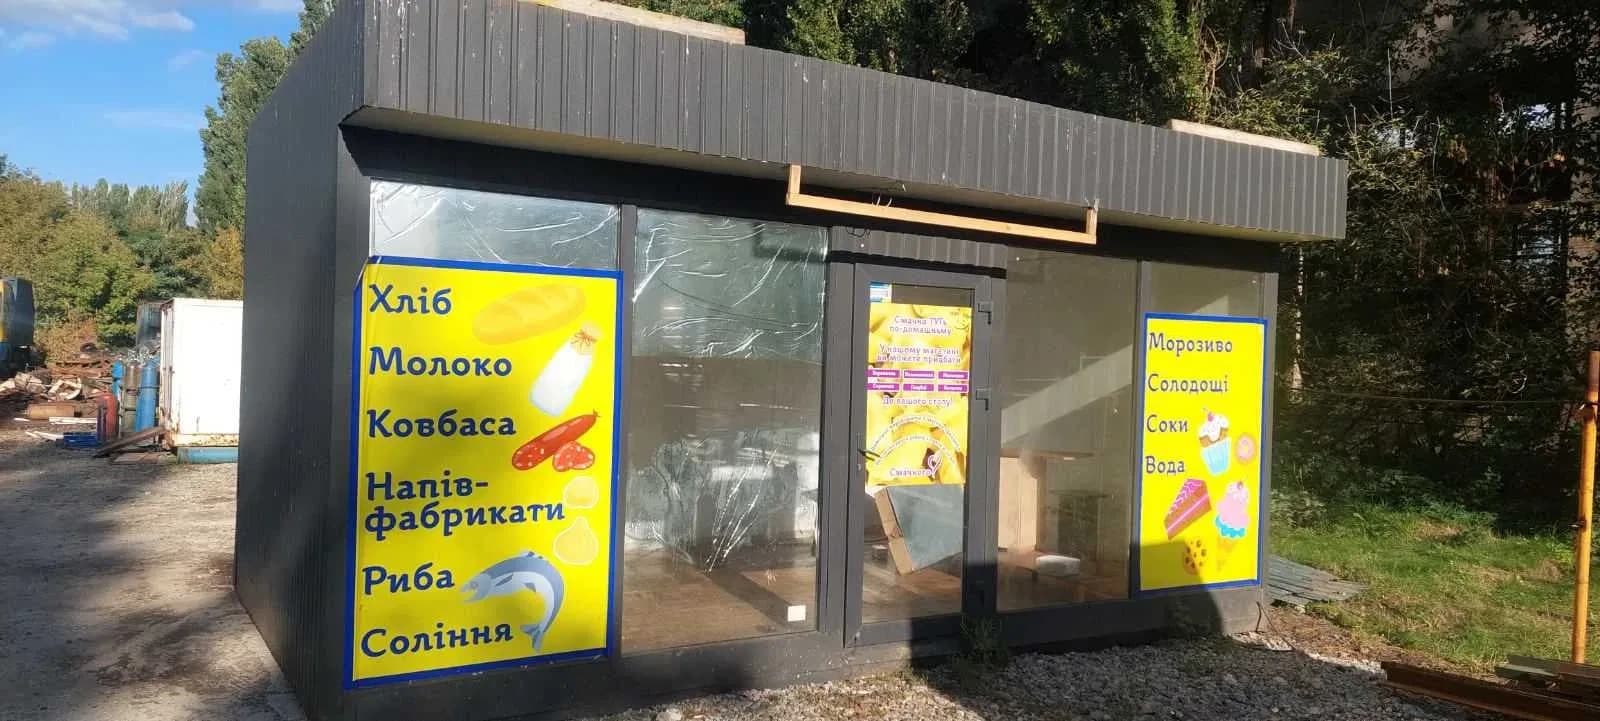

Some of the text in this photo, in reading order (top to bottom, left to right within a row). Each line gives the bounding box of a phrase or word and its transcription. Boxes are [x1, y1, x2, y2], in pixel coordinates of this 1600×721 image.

[369, 283, 452, 316] Хліб
[1149, 332, 1233, 357] Морозиво
[369, 346, 513, 378] Молоко
[1147, 373, 1228, 395] Солодощі
[366, 409, 516, 440] Ковбаса
[1146, 414, 1189, 433] Соки
[1145, 455, 1185, 475] Вода
[366, 471, 489, 502] Напів-
[364, 502, 566, 542] фабрикати
[362, 562, 455, 597] Риба
[361, 622, 514, 658] Соління
